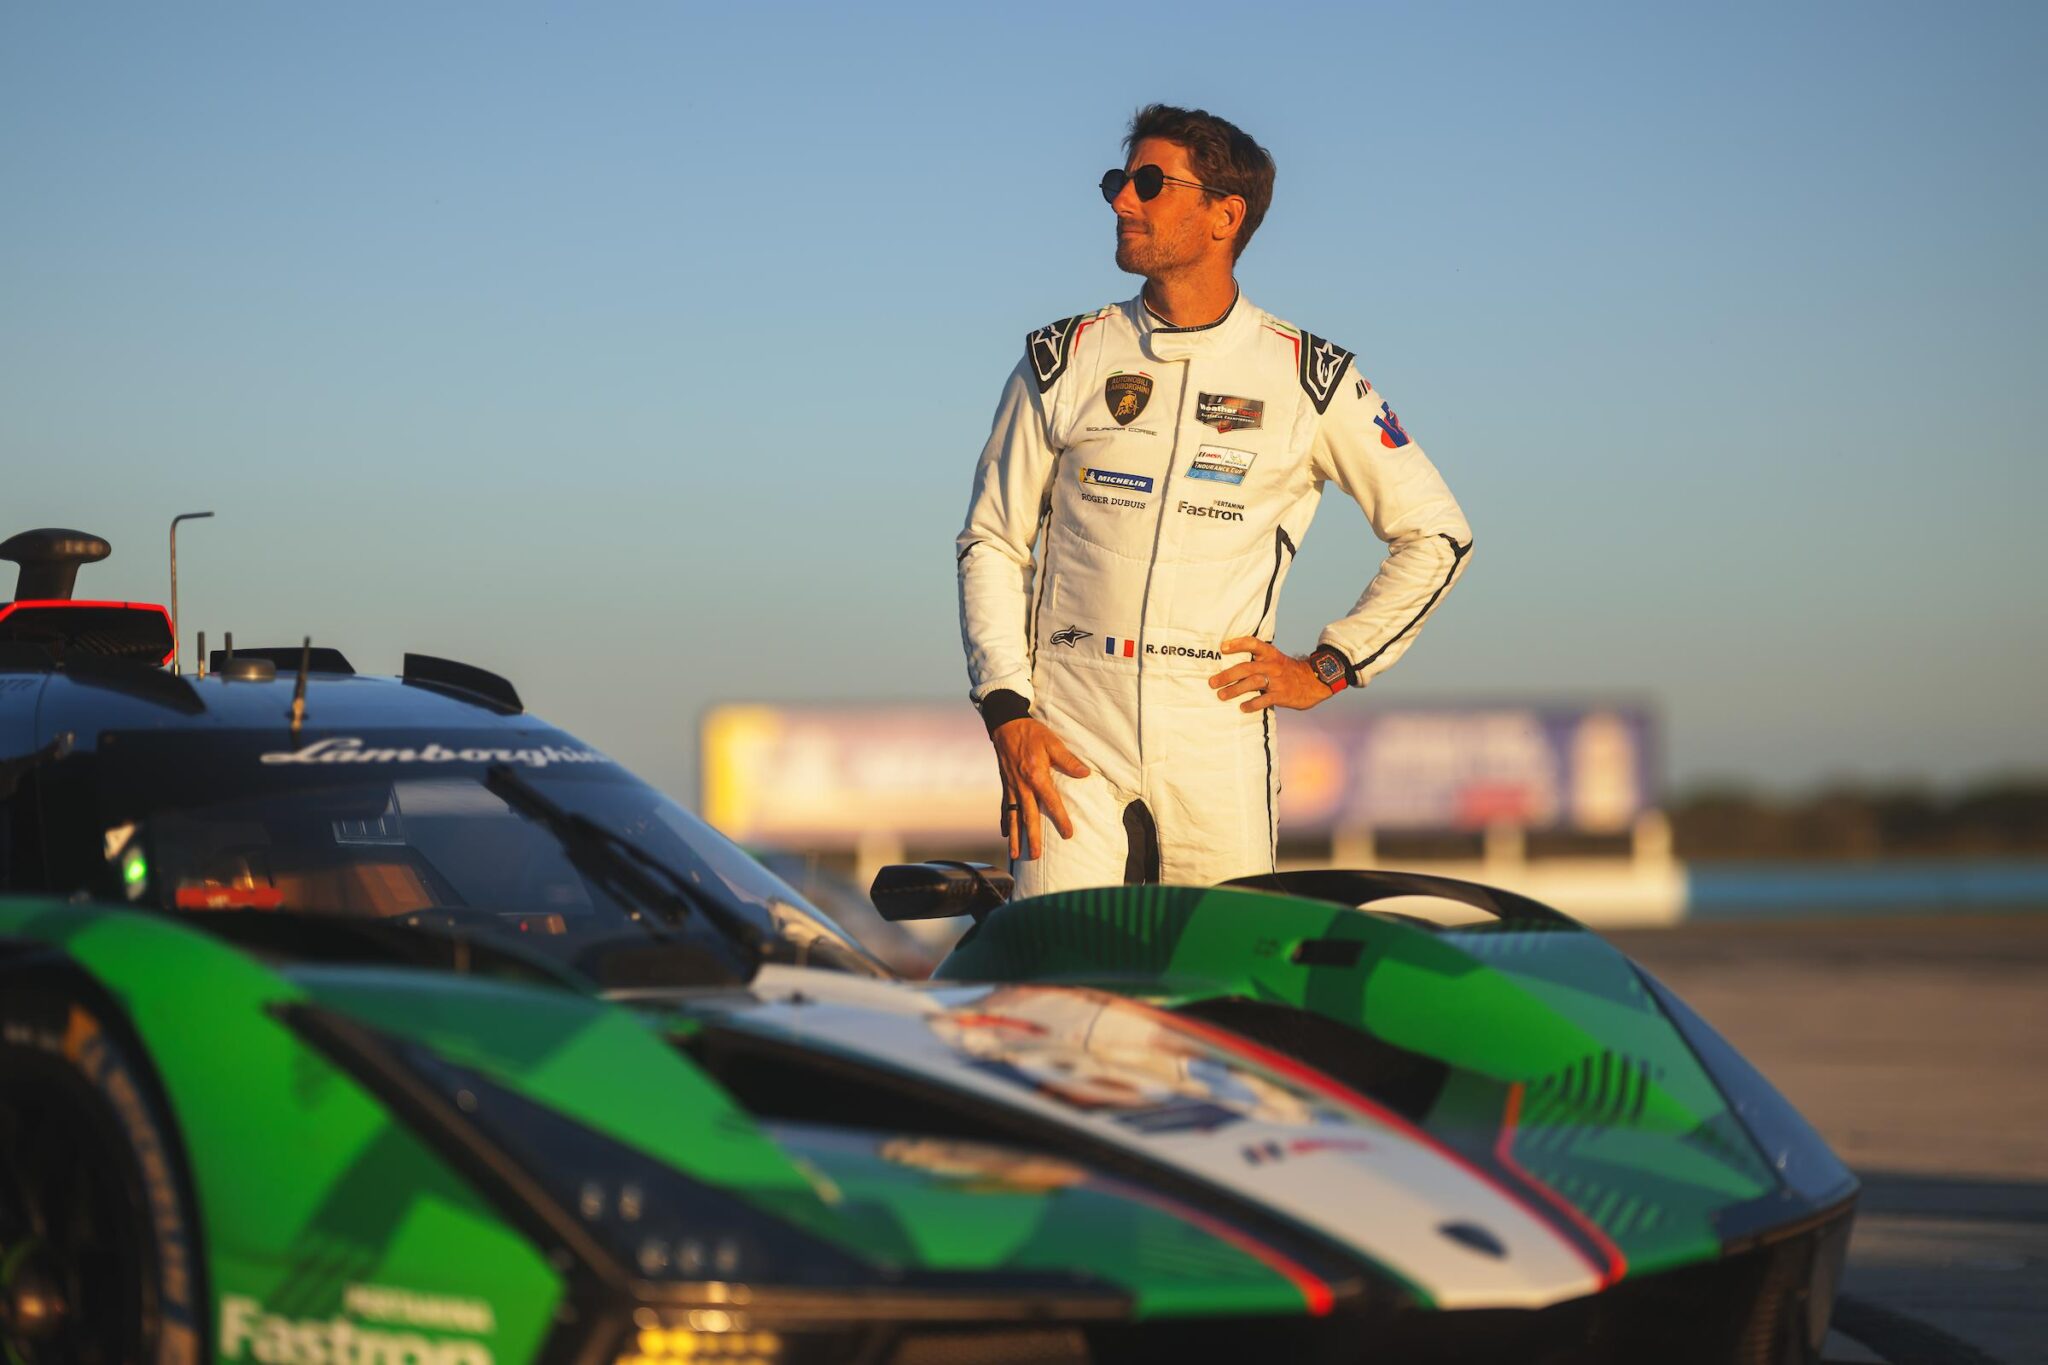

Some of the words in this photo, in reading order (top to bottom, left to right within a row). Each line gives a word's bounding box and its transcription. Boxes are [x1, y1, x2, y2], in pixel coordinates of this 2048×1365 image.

[1128, 427, 1158, 436] CORSE
[1097, 474, 1147, 488] MICHELIN
[1081, 493, 1109, 505] ROGER
[1111, 497, 1146, 510] DUBUIS
[1213, 499, 1245, 510] PERTAMINA
[1177, 500, 1244, 521] Fastron
[1146, 644, 1158, 654] R.
[1161, 645, 1222, 661] GROSJEAN
